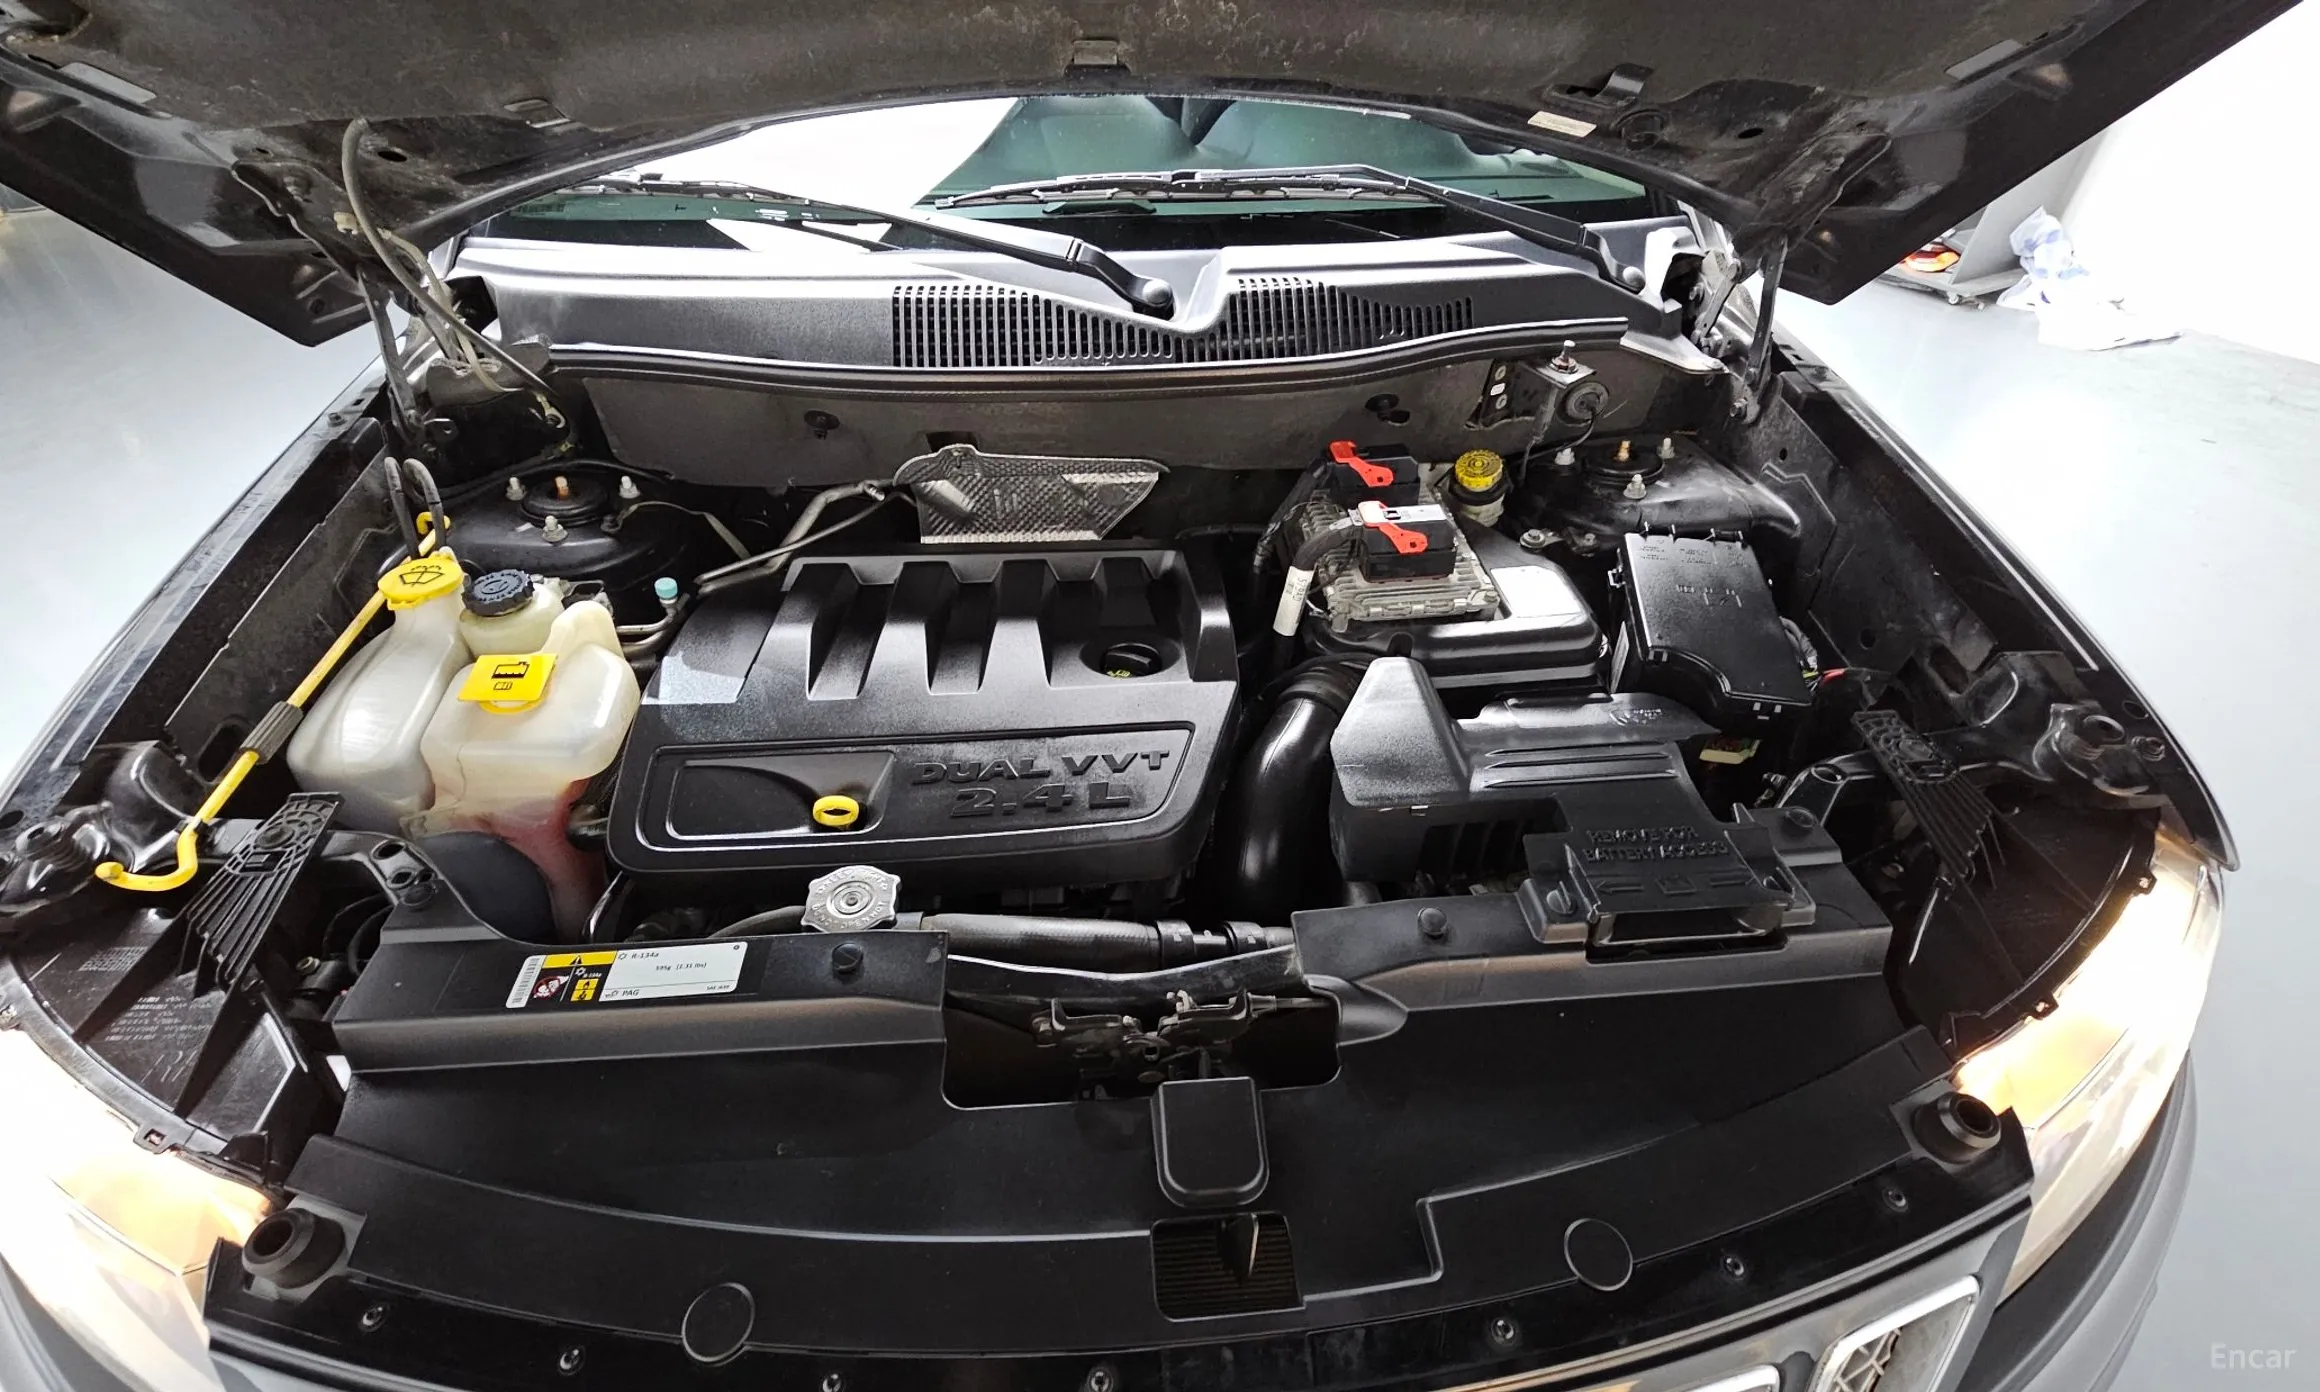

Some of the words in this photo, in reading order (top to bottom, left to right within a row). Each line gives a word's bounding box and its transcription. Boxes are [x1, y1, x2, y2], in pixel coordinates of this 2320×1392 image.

[912, 758, 1051, 785] DUAL
[1062, 750, 1170, 776] VVT
[631, 952, 659, 960] R-134a
[622, 988, 640, 997] PAG
